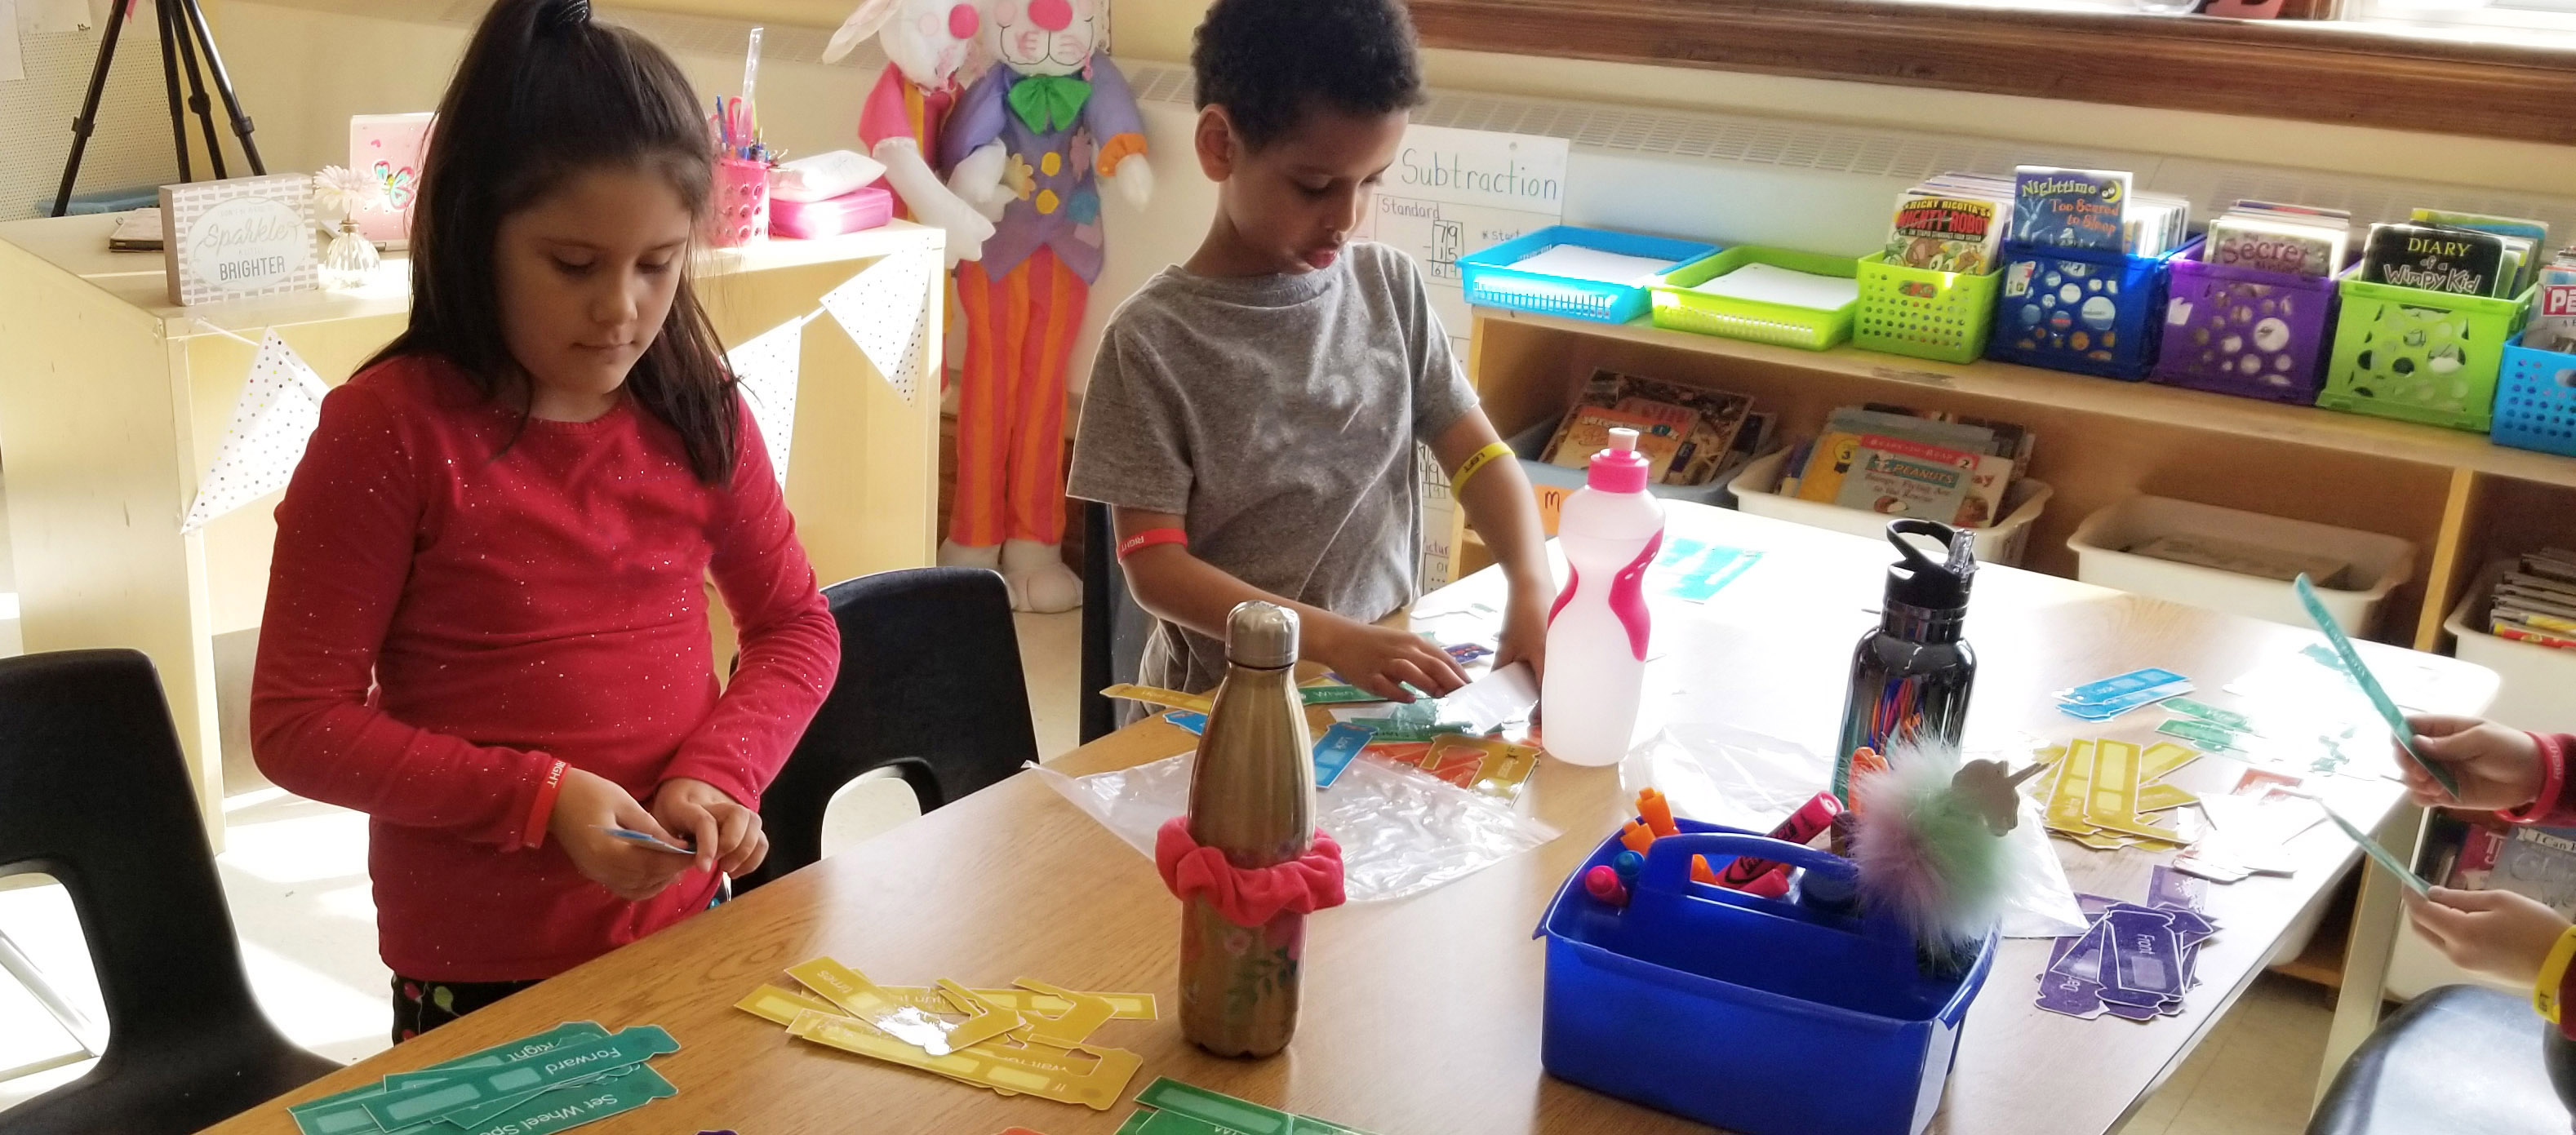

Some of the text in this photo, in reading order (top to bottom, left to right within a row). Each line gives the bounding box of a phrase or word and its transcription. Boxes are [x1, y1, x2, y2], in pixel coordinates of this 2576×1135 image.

[1401, 148, 1557, 201] Subtraction
[2021, 177, 2096, 197] Nighttime
[1381, 197, 1440, 221] Standard
[1911, 199, 1939, 209] RICKY
[2050, 198, 2121, 215] Too Scared
[1896, 210, 1948, 230] MIGHTY
[2067, 214, 2116, 237] to Sleep
[196, 215, 291, 258] Sparkle
[1434, 224, 1459, 246] 79
[2221, 237, 2309, 268] Secret
[2408, 237, 2473, 257] DIARY
[220, 255, 286, 281] BRIGHTER
[2420, 255, 2448, 271] of a
[2383, 264, 2481, 295] Wimpy Kid
[1894, 463, 1955, 485] PEANUTS
[1959, 459, 1970, 469] 2
[1424, 539, 1450, 555] ictur
[2543, 836, 2567, 849] Can
[544, 1047, 622, 1075] Forward
[583, 1093, 618, 1109] Set
[520, 1104, 584, 1129] Wheel
